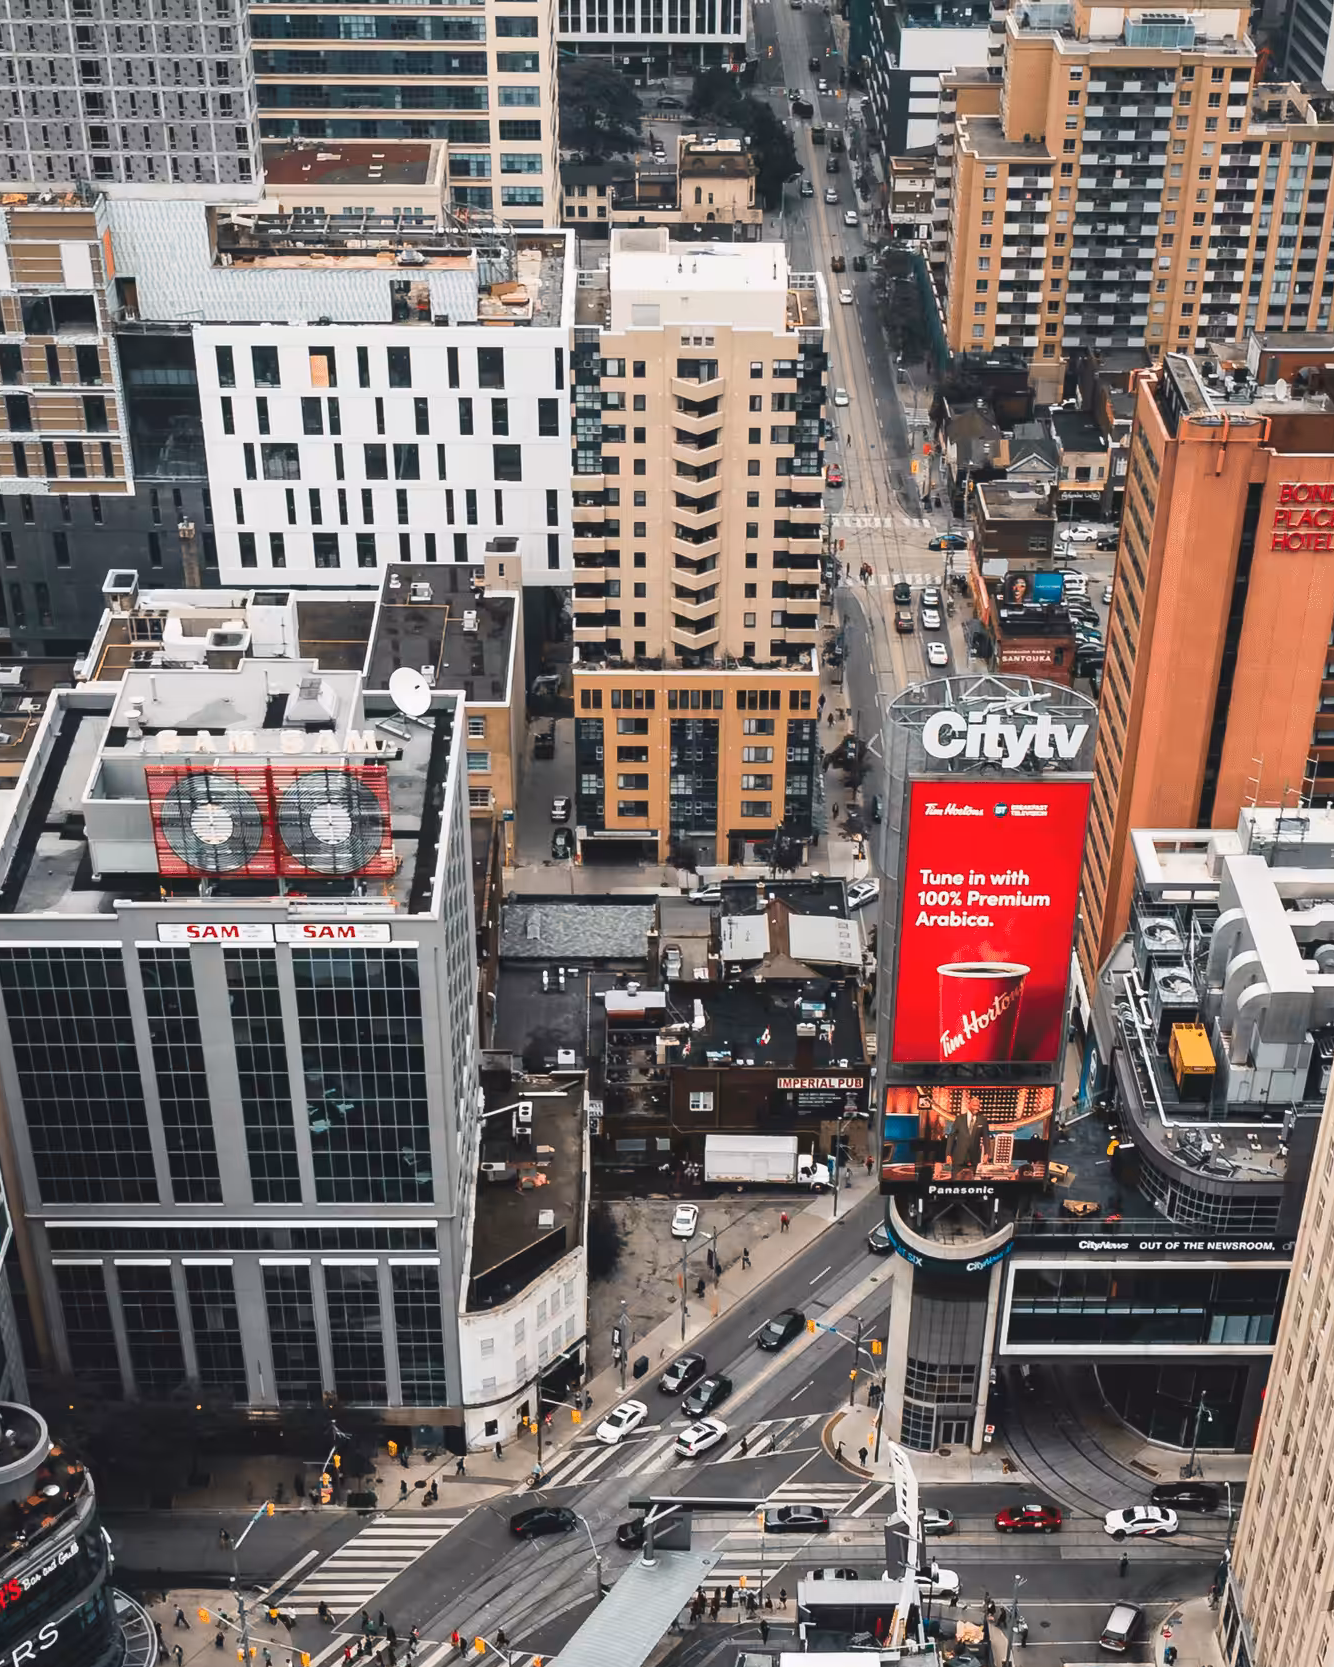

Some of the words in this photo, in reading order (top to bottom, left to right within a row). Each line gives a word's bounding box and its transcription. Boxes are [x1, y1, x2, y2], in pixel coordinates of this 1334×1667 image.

[280, 729, 378, 754] SAM
[922, 711, 1089, 768] Citytv
[925, 803, 943, 816] Tim
[944, 803, 984, 816] Hortons
[920, 869, 964, 885] Tune
[969, 869, 985, 885] in
[990, 869, 1030, 886] with
[918, 891, 962, 906] 100%
[967, 891, 1050, 906] Premium
[915, 911, 994, 927] Arabica.
[187, 925, 240, 938] SAM
[303, 925, 356, 938] SAM
[940, 1030, 965, 1057] Tim
[778, 1078, 835, 1088] IMPERIAL
[838, 1078, 863, 1088] PUB
[928, 1185, 994, 1195] Panasonic
[1079, 1240, 1129, 1251] CityNews
[1139, 1242, 1161, 1250] OUT
[1165, 1242, 1180, 1250] OF
[1183, 1242, 1204, 1250] THE
[1207, 1242, 1276, 1251] NEWSROOM,
[907, 1254, 923, 1267] SIX
